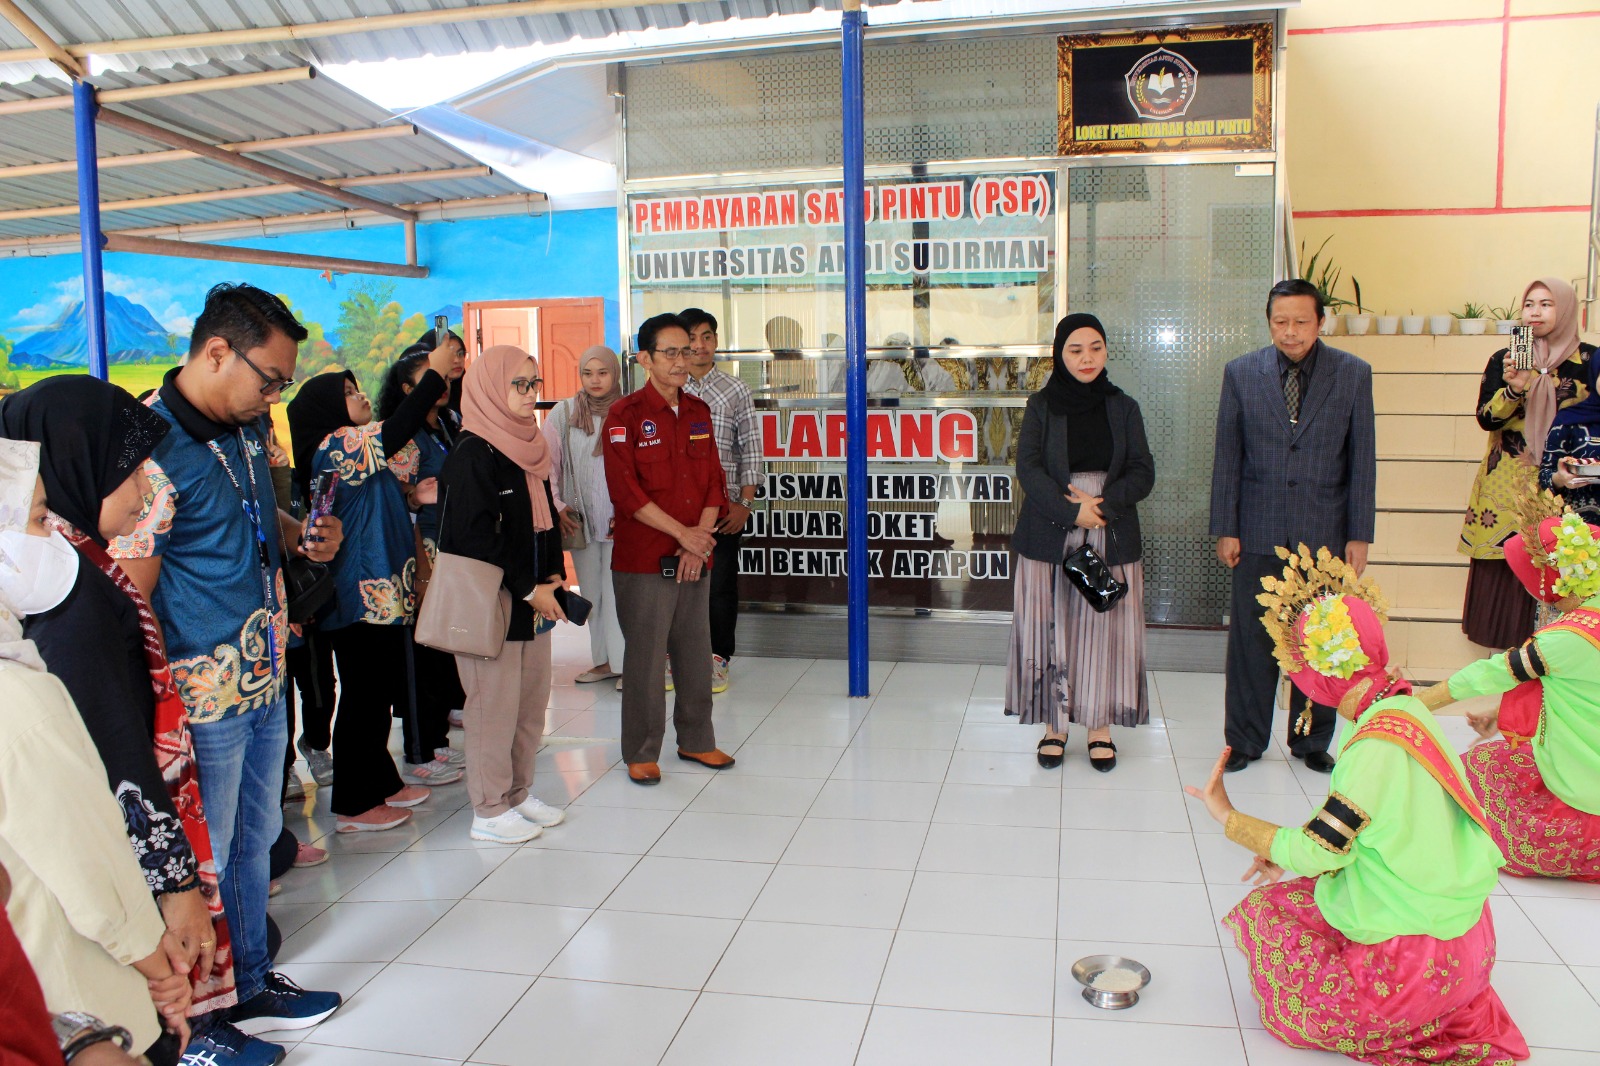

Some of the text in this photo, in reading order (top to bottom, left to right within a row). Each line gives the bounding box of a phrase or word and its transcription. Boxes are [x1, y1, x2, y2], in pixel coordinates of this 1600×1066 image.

[1075, 118, 1252, 141] LOKET PEMBAYARAN SATU PINTU
[634, 193, 796, 233] PEMBAYARAN
[881, 184, 961, 221] PINTU
[972, 178, 1048, 221] (PSP)
[635, 246, 805, 280] UNIVERSITAS
[893, 239, 1045, 272] SUDIRMAN
[761, 412, 976, 459] LARANG
[867, 474, 1011, 501] EMBAYAR
[772, 511, 843, 536] LUAR
[867, 513, 936, 539] OKET
[771, 550, 881, 576] BENTK
[893, 551, 1009, 578] APAPUN
